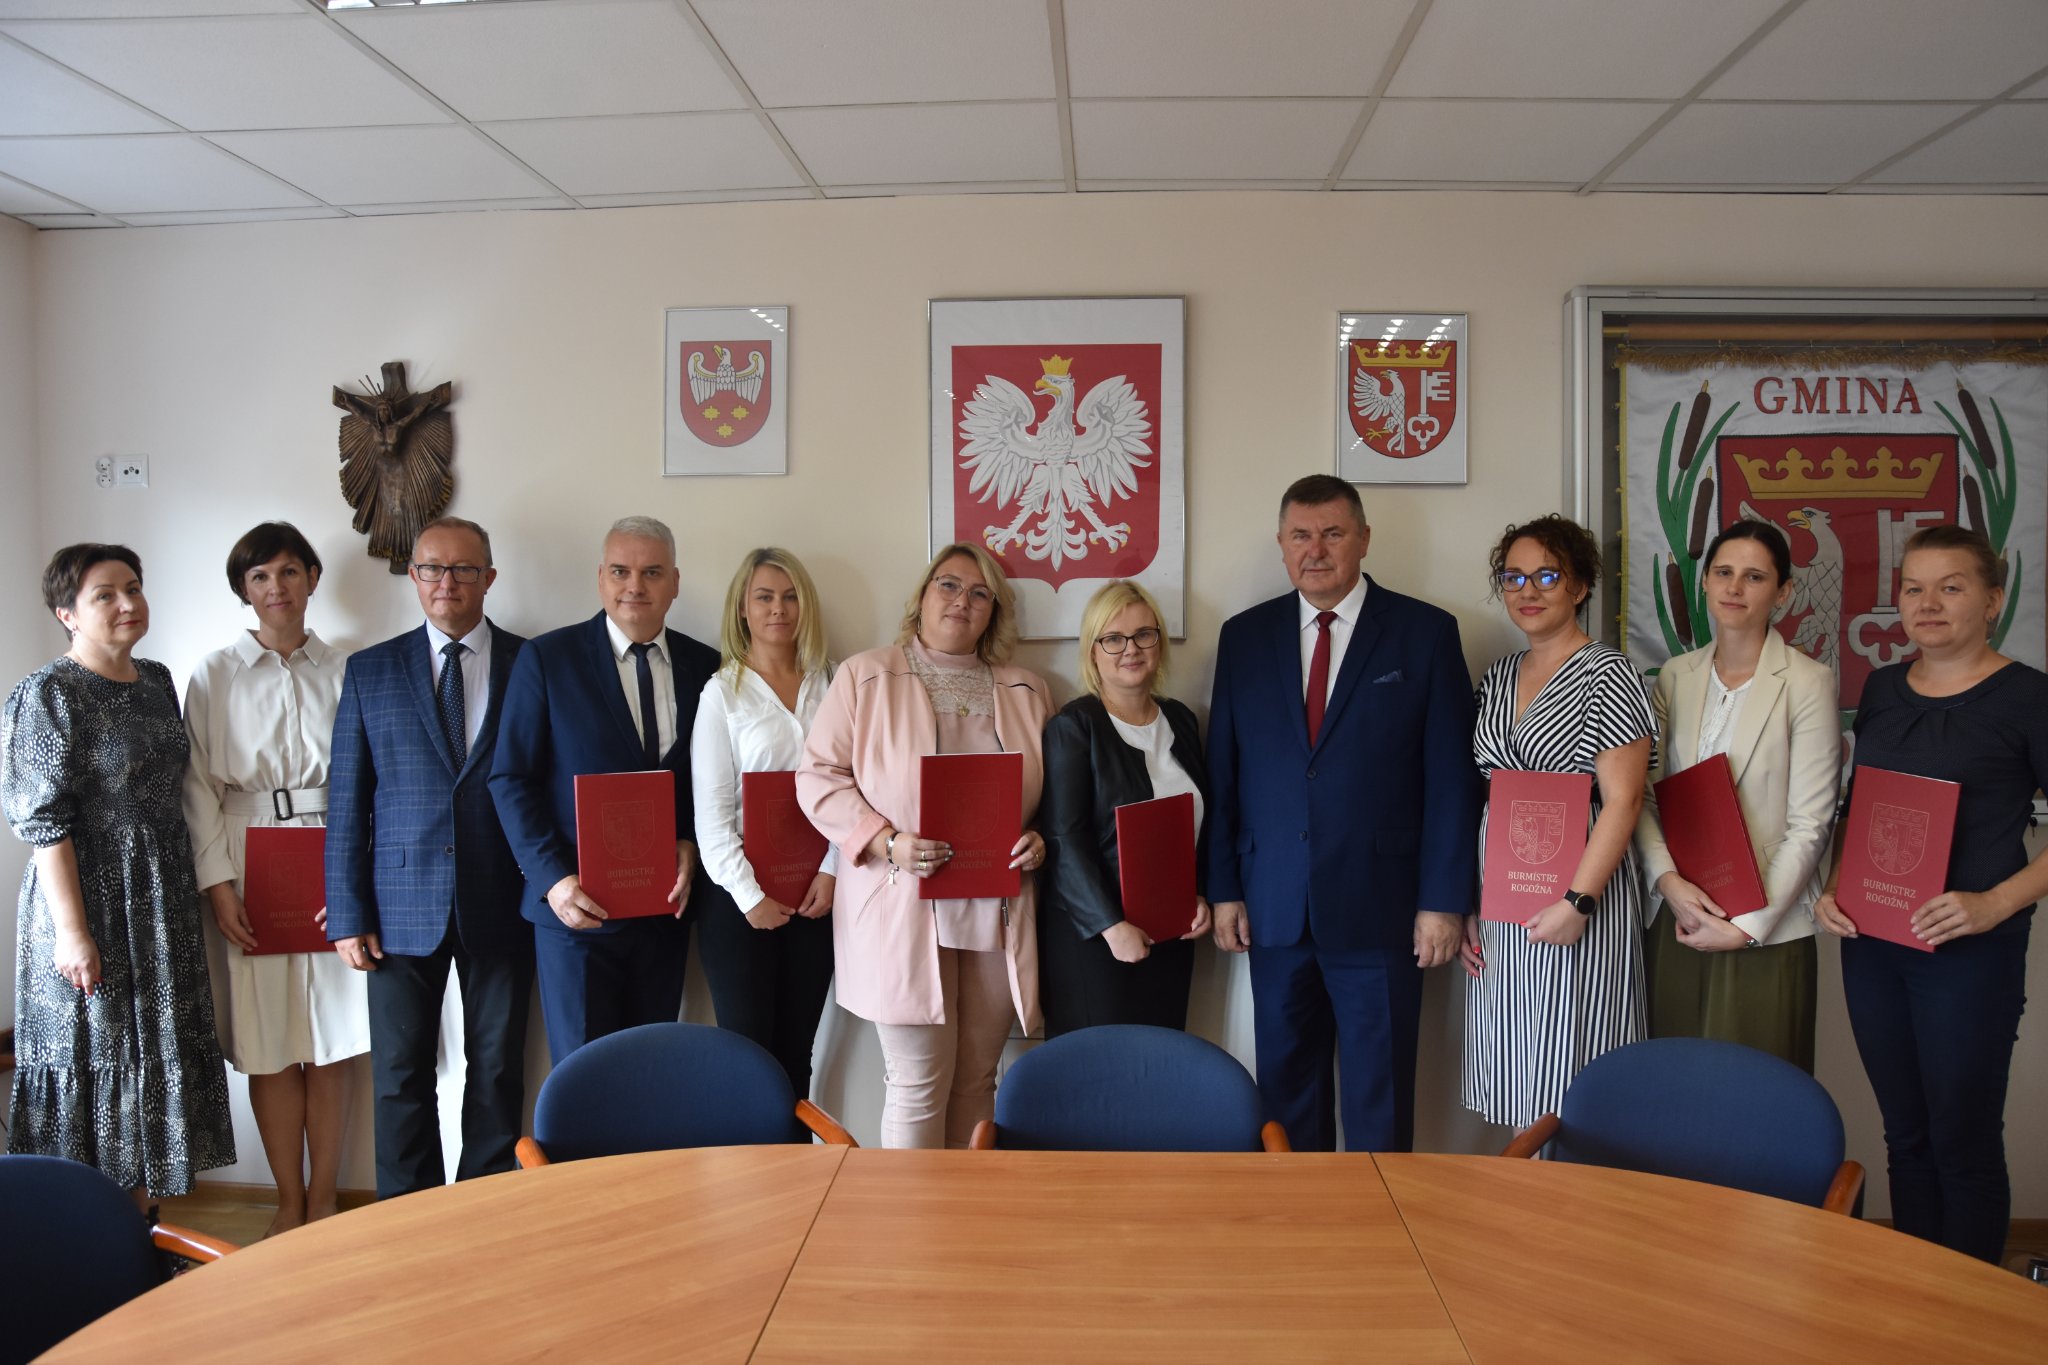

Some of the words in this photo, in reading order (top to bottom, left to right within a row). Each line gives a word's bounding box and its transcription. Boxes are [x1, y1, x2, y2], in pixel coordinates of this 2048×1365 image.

[1753, 376, 1923, 414] GMINA
[1508, 871, 1558, 883] BURMISTRZ
[1511, 882, 1552, 894] ROGOŹNA
[1863, 878, 1917, 899] BURMISTRZ
[1866, 891, 1909, 911] ROGOŹNA
